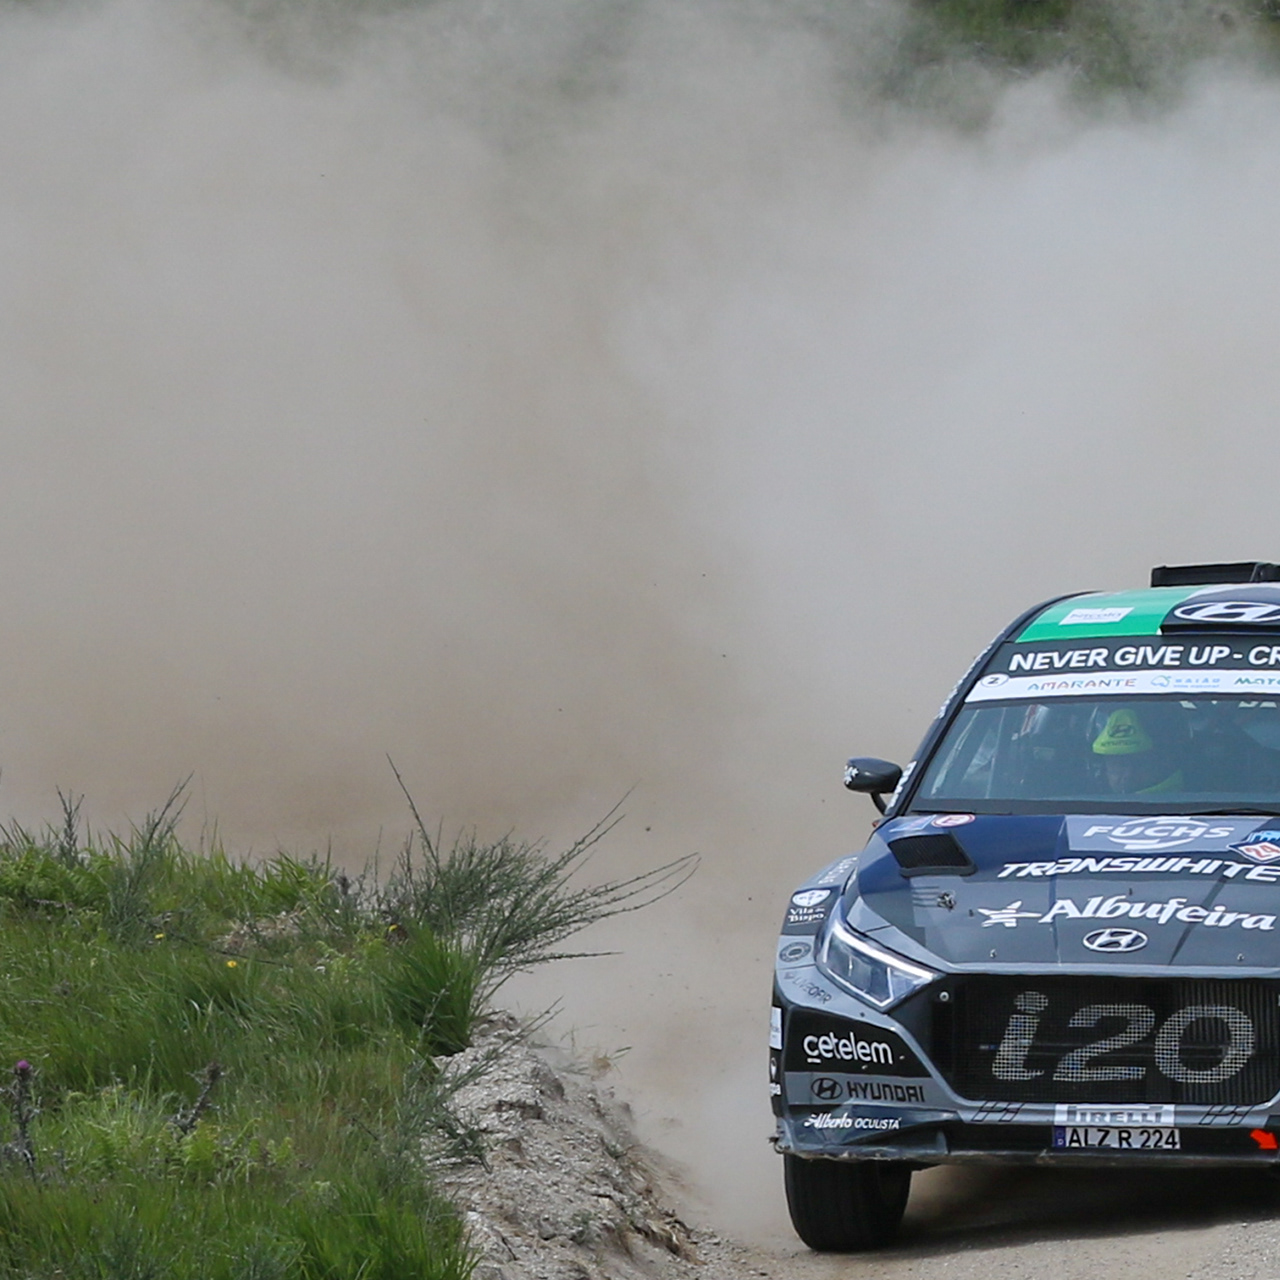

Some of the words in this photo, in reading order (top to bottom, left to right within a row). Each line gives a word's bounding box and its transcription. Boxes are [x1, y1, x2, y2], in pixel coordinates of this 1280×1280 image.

[1009, 648, 1108, 671] NEVER
[1114, 645, 1204, 666] GIVE
[1188, 645, 1230, 665] UP
[1027, 678, 1138, 691] AMARANTE
[1083, 825, 1235, 838] FUCHS
[1038, 895, 1277, 931] Albufeira
[992, 990, 1255, 1084] i20
[803, 1031, 893, 1065] cetelem
[847, 1081, 926, 1103] HYUNDAI
[804, 1112, 852, 1129] Alberto
[854, 1117, 902, 1129] OCULISTA
[1067, 1105, 1163, 1124] PIRELLI
[1068, 1128, 1112, 1148] ALZ
[1118, 1128, 1134, 1148] R
[1139, 1128, 1178, 1149] 224
